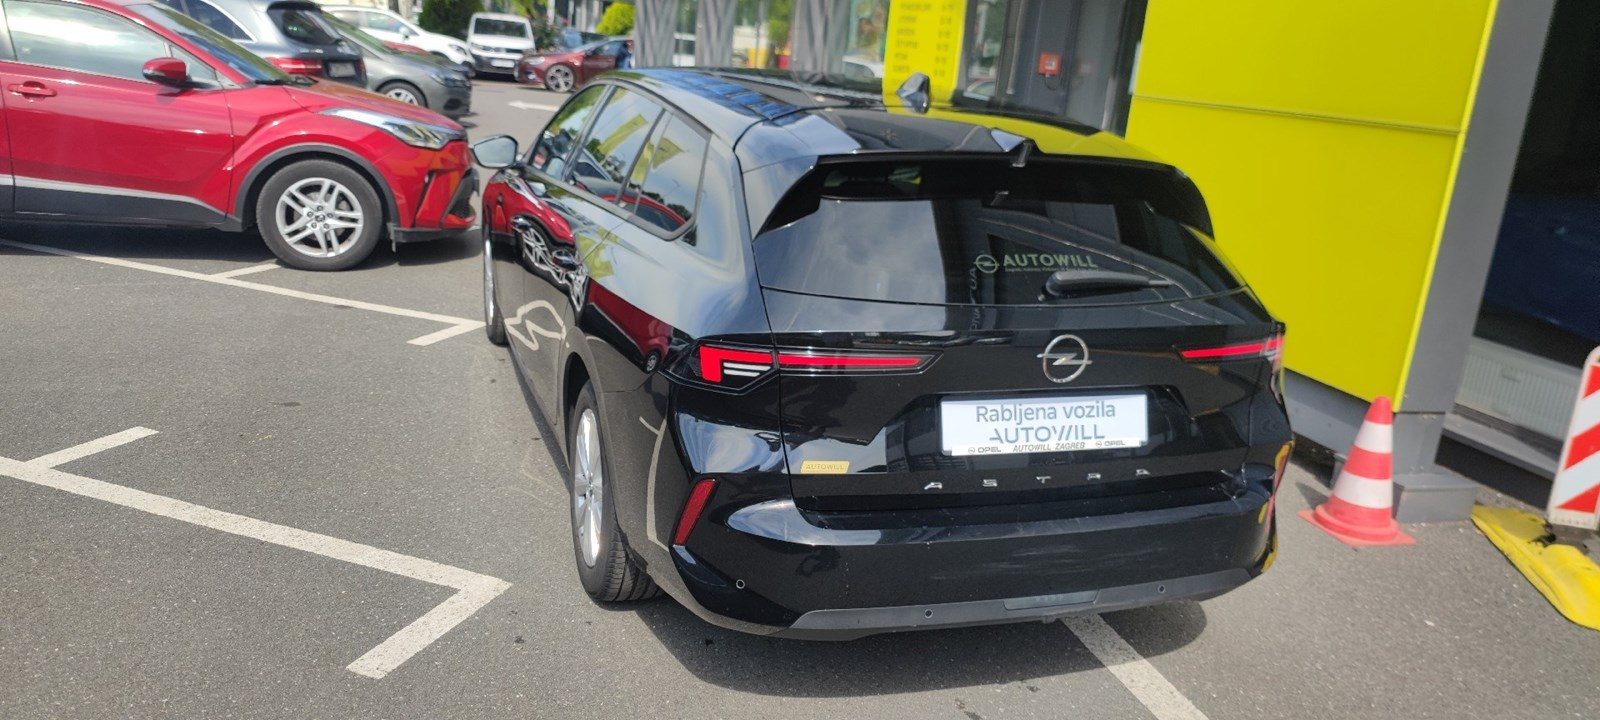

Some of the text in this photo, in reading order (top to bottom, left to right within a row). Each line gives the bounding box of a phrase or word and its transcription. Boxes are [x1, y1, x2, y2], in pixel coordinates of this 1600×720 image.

[1003, 254, 1098, 268] AUTOWILL
[976, 400, 1116, 424] Rabljena vozila
[989, 424, 1105, 444] AUTOWILL
[1013, 444, 1051, 453] AUTOWILL
[1055, 442, 1086, 451] ZAGREB
[924, 468, 1150, 490] ASTRA
